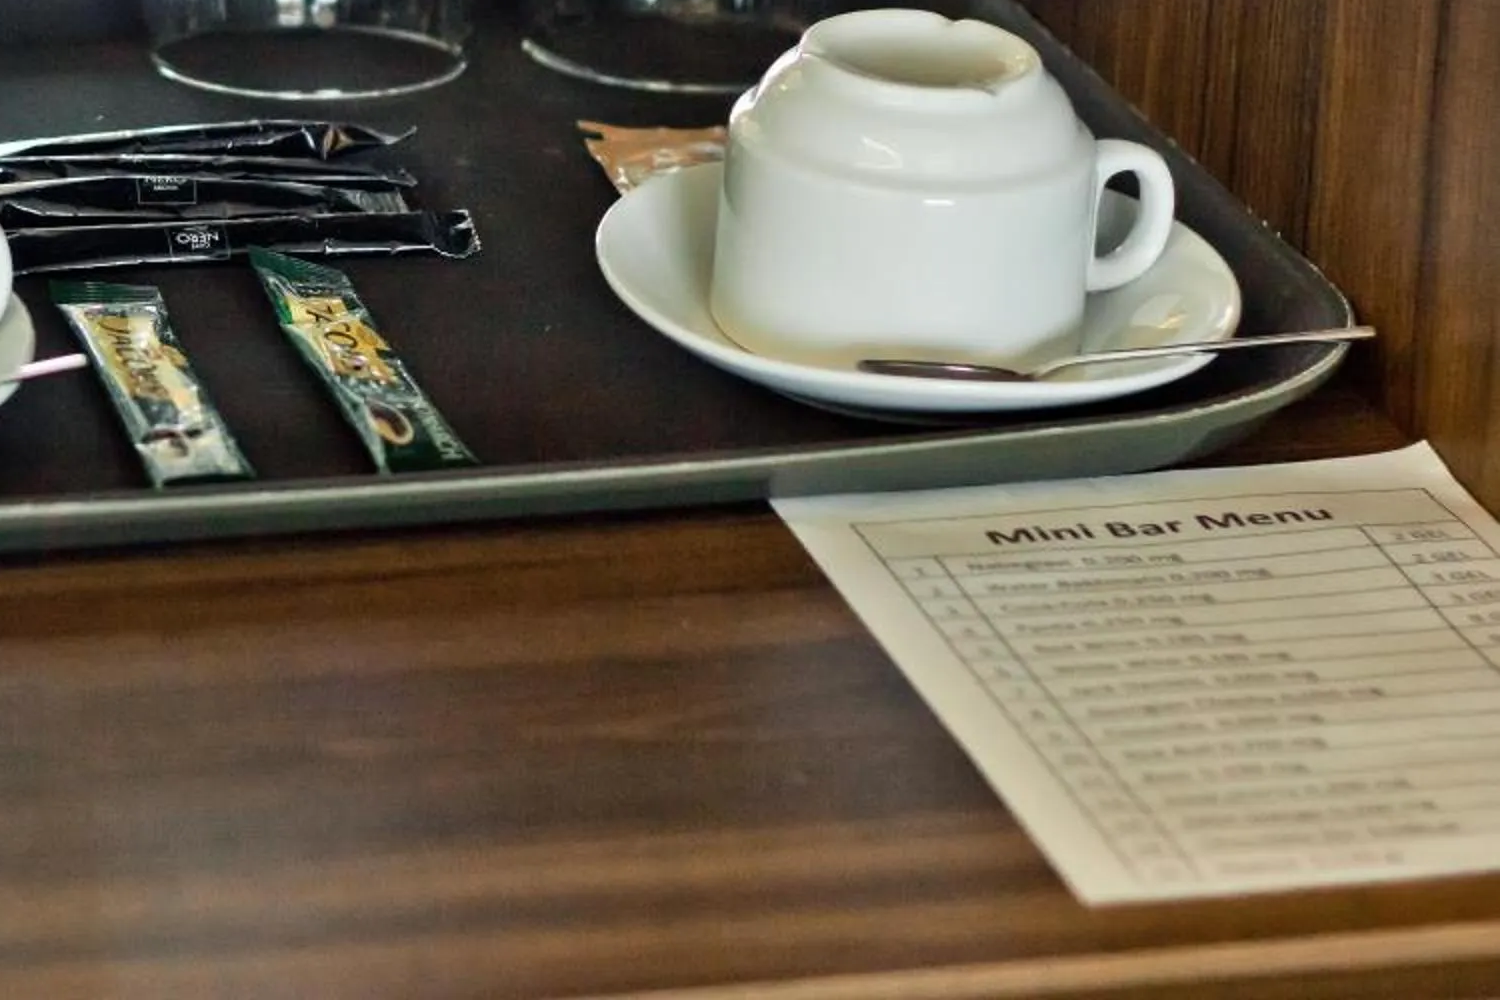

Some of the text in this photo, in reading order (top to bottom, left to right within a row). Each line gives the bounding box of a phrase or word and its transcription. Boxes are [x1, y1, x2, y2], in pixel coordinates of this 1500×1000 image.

[175, 231, 219, 245] NERO
[985, 507, 1335, 546] Mini Bar Menu
